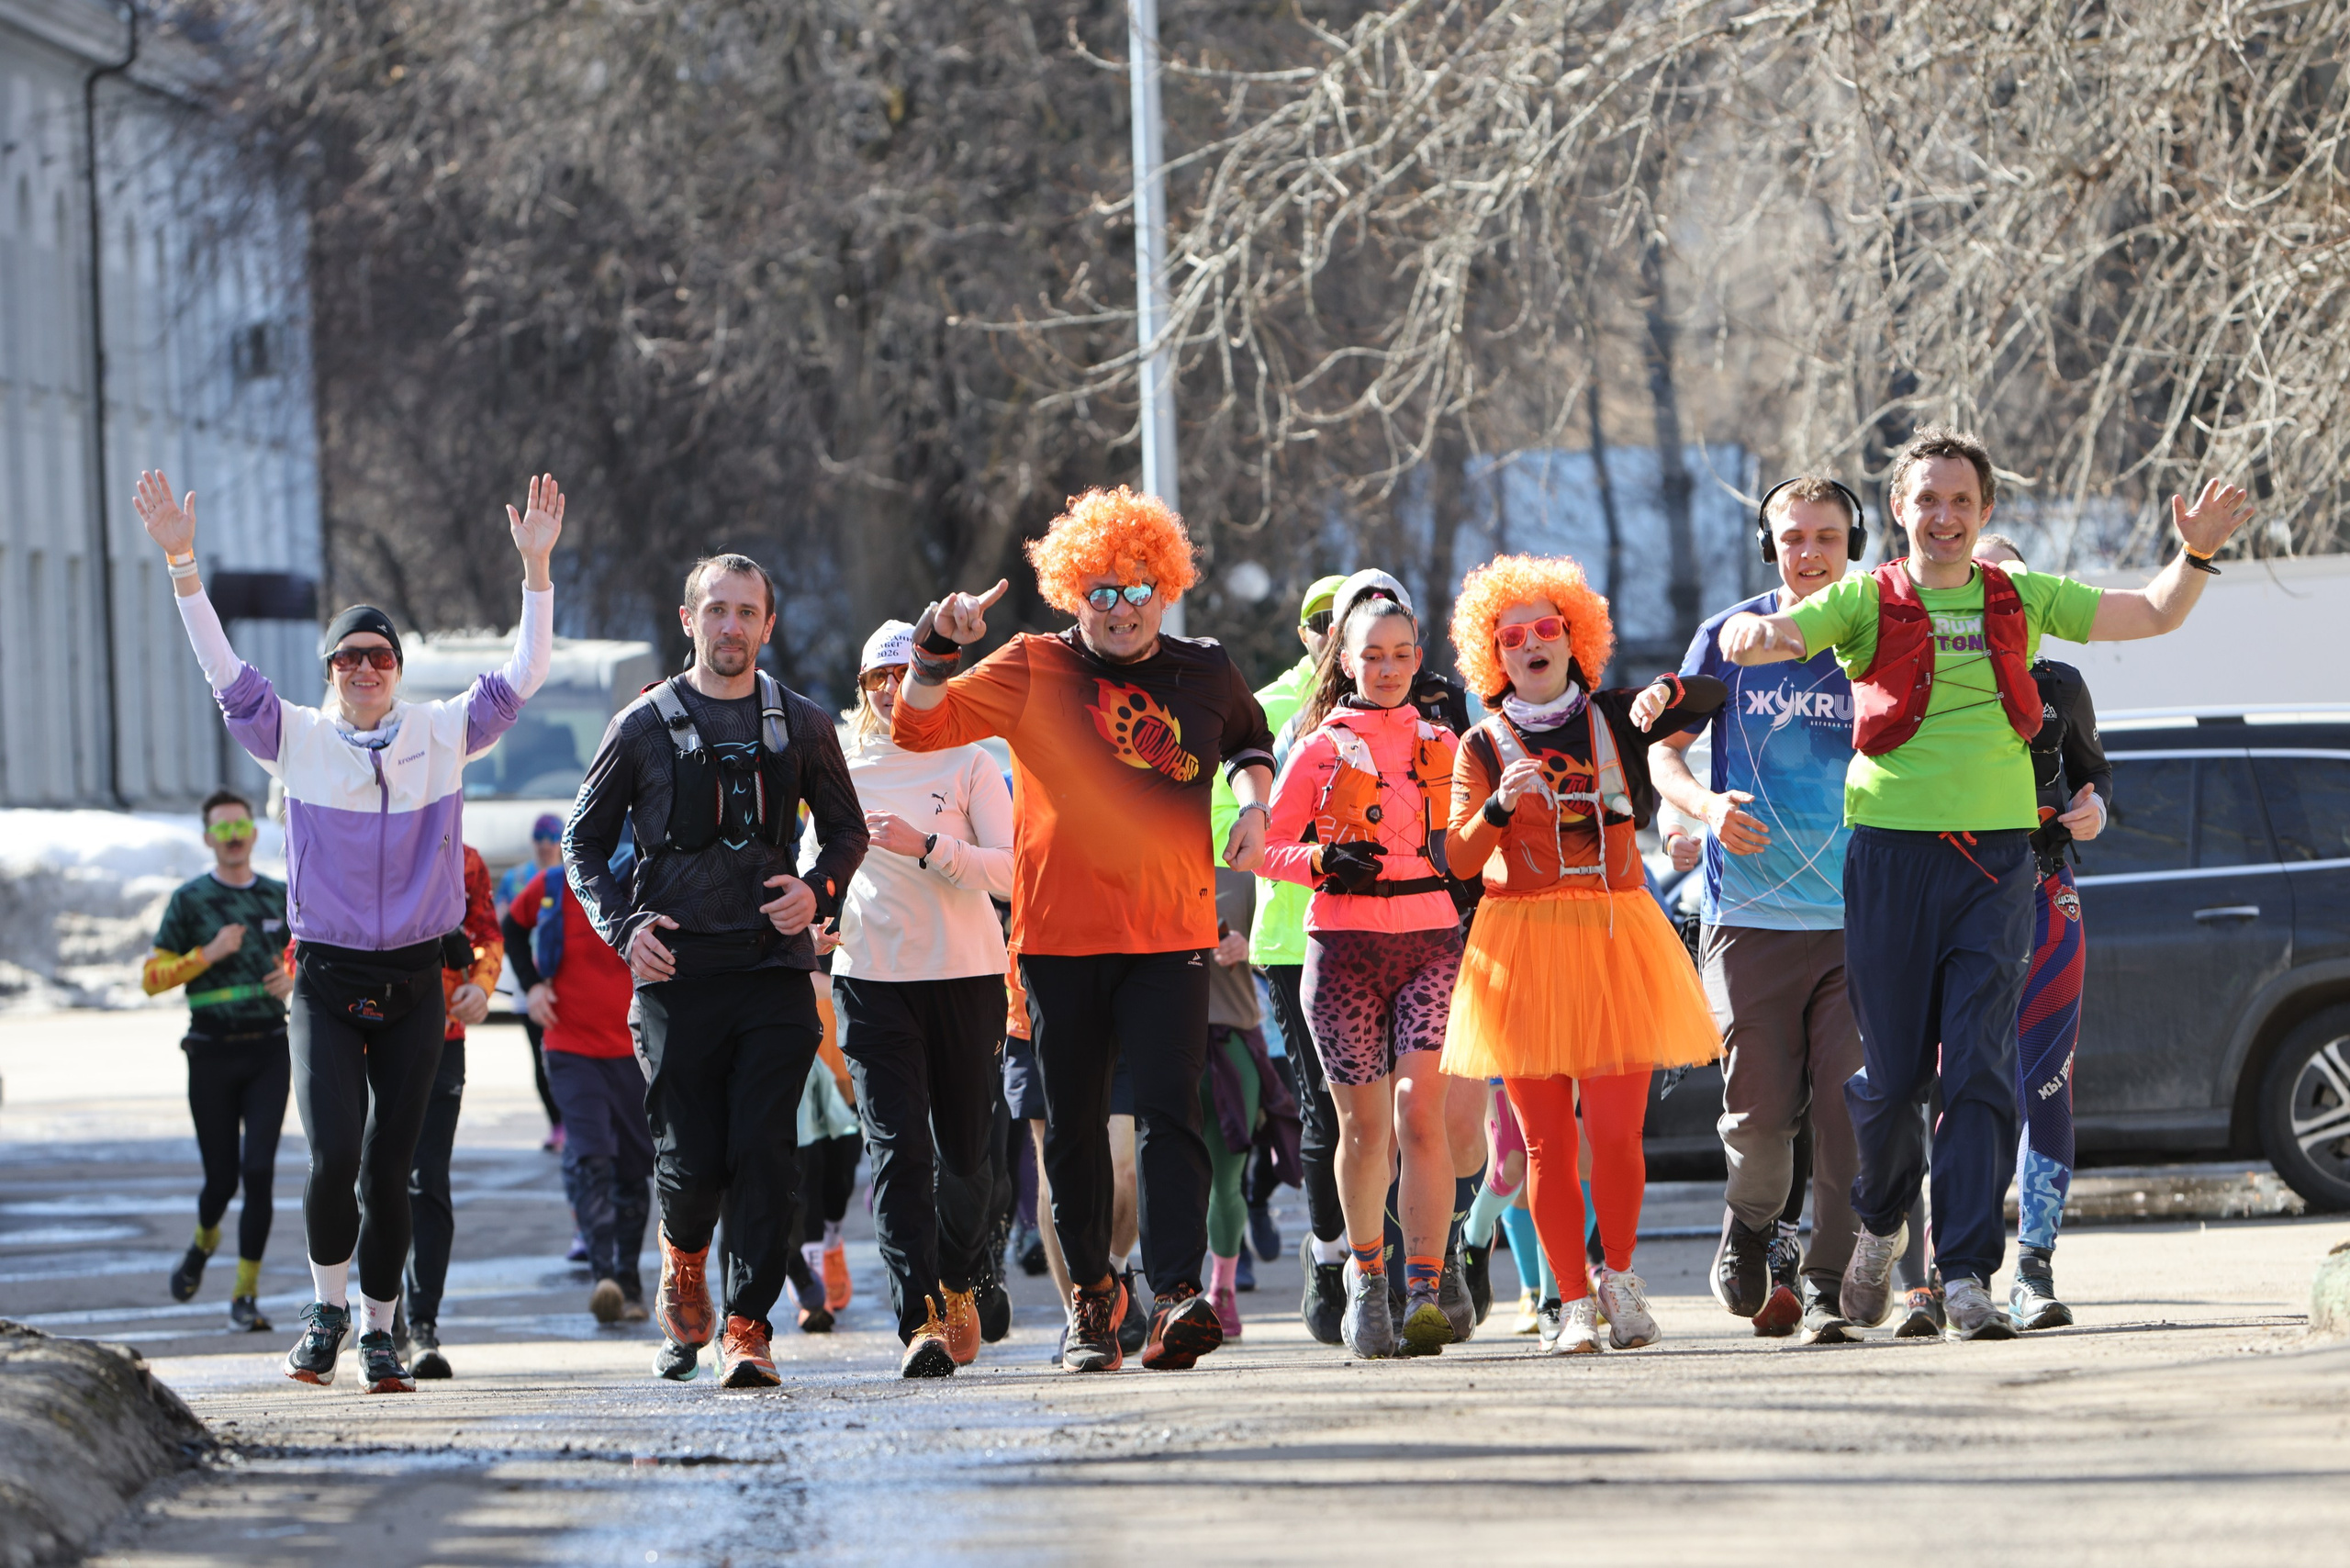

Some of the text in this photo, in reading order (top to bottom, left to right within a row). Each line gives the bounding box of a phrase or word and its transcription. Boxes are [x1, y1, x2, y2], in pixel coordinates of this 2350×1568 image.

[1934, 617, 1982, 634] RUN
[1937, 633, 1986, 651] TON
[1745, 679, 1854, 732] ЖУКRU
[2038, 1075, 2064, 1101] МЫ
